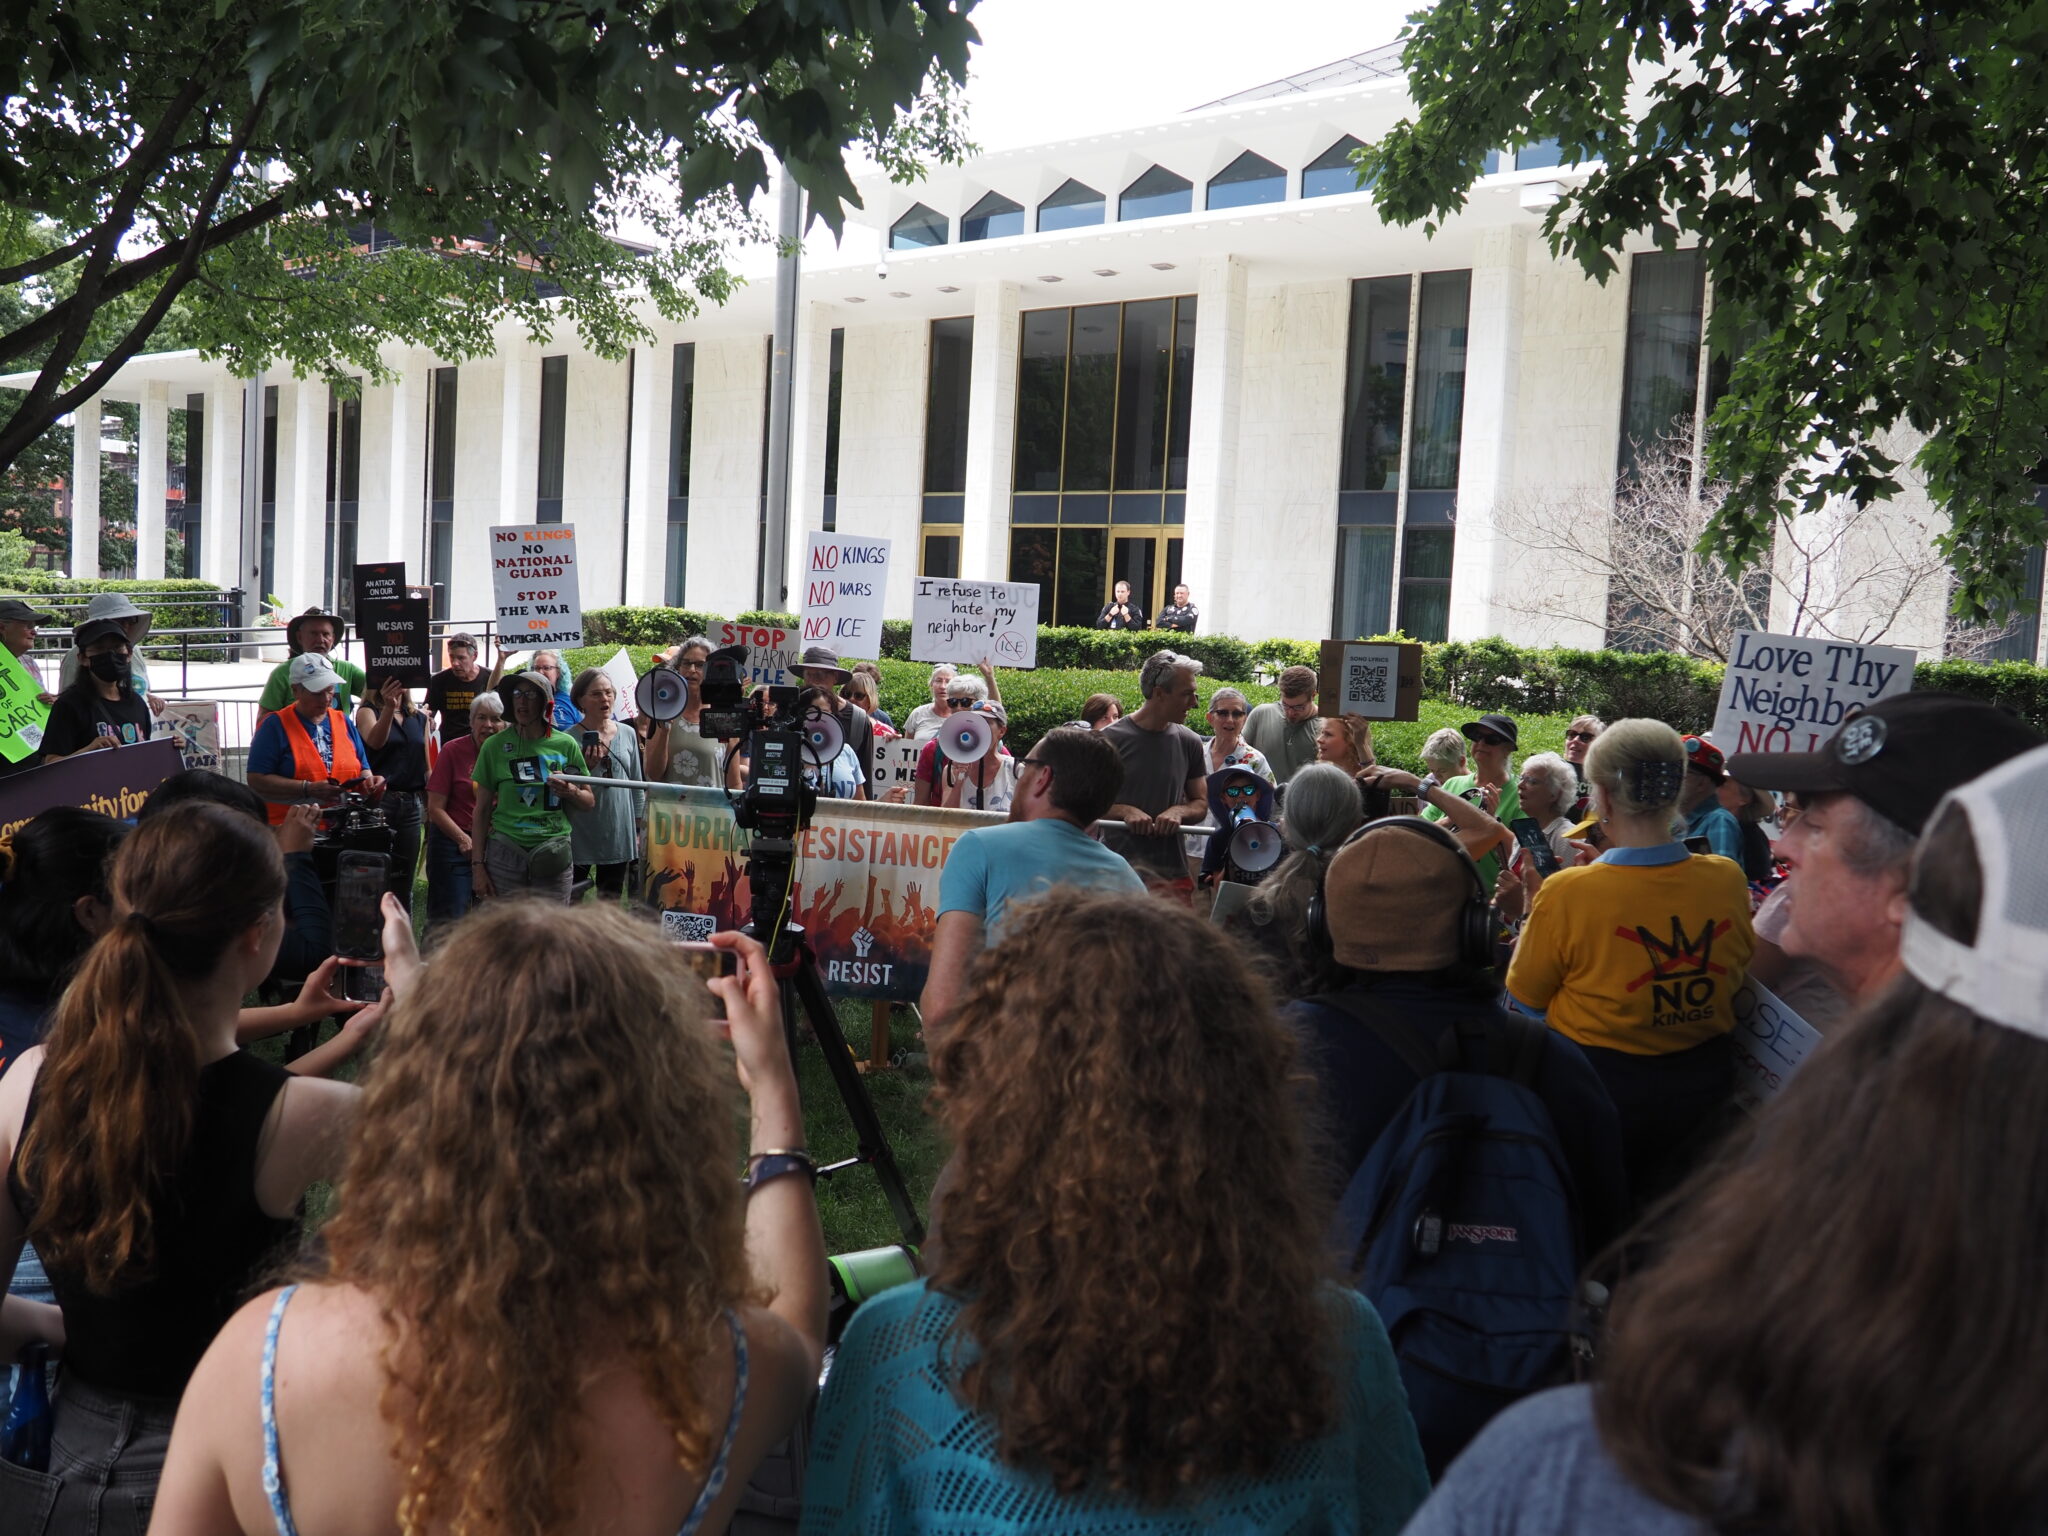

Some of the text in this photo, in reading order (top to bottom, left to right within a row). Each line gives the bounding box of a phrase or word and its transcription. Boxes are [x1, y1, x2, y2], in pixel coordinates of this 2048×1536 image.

[495, 529, 573, 543] NO KINGS
[522, 544, 544, 555] NO
[495, 555, 573, 569] NATIONAL
[812, 545, 886, 570] NO KINGS
[510, 566, 563, 579] GUARD
[365, 579, 396, 588] AN ATTACK
[917, 581, 1006, 600] I refuse to
[370, 587, 393, 596] ON OUR
[517, 590, 557, 601] STOP
[808, 580, 872, 606] NO WARS
[499, 604, 570, 616] THE WAR
[951, 600, 983, 615] hate
[995, 607, 1017, 625] my
[377, 621, 414, 631] NC SAYS
[528, 619, 549, 630] ON
[804, 616, 867, 639] NO ICE
[720, 623, 786, 650] STOP
[381, 645, 409, 655] TO ICE
[1000, 640, 1024, 653] ICE
[371, 657, 421, 667] EXPANSION
[1733, 634, 1900, 699] Love Thy
[1, 698, 13, 710] OF
[1735, 720, 1791, 753] NO
[654, 810, 957, 869] DURHA ESISTANCE
[828, 959, 893, 986] RESIST
[1651, 976, 1715, 1014] NO
[1651, 1004, 1715, 1028] KINGS
[1448, 1223, 1518, 1244] JANSPORT
